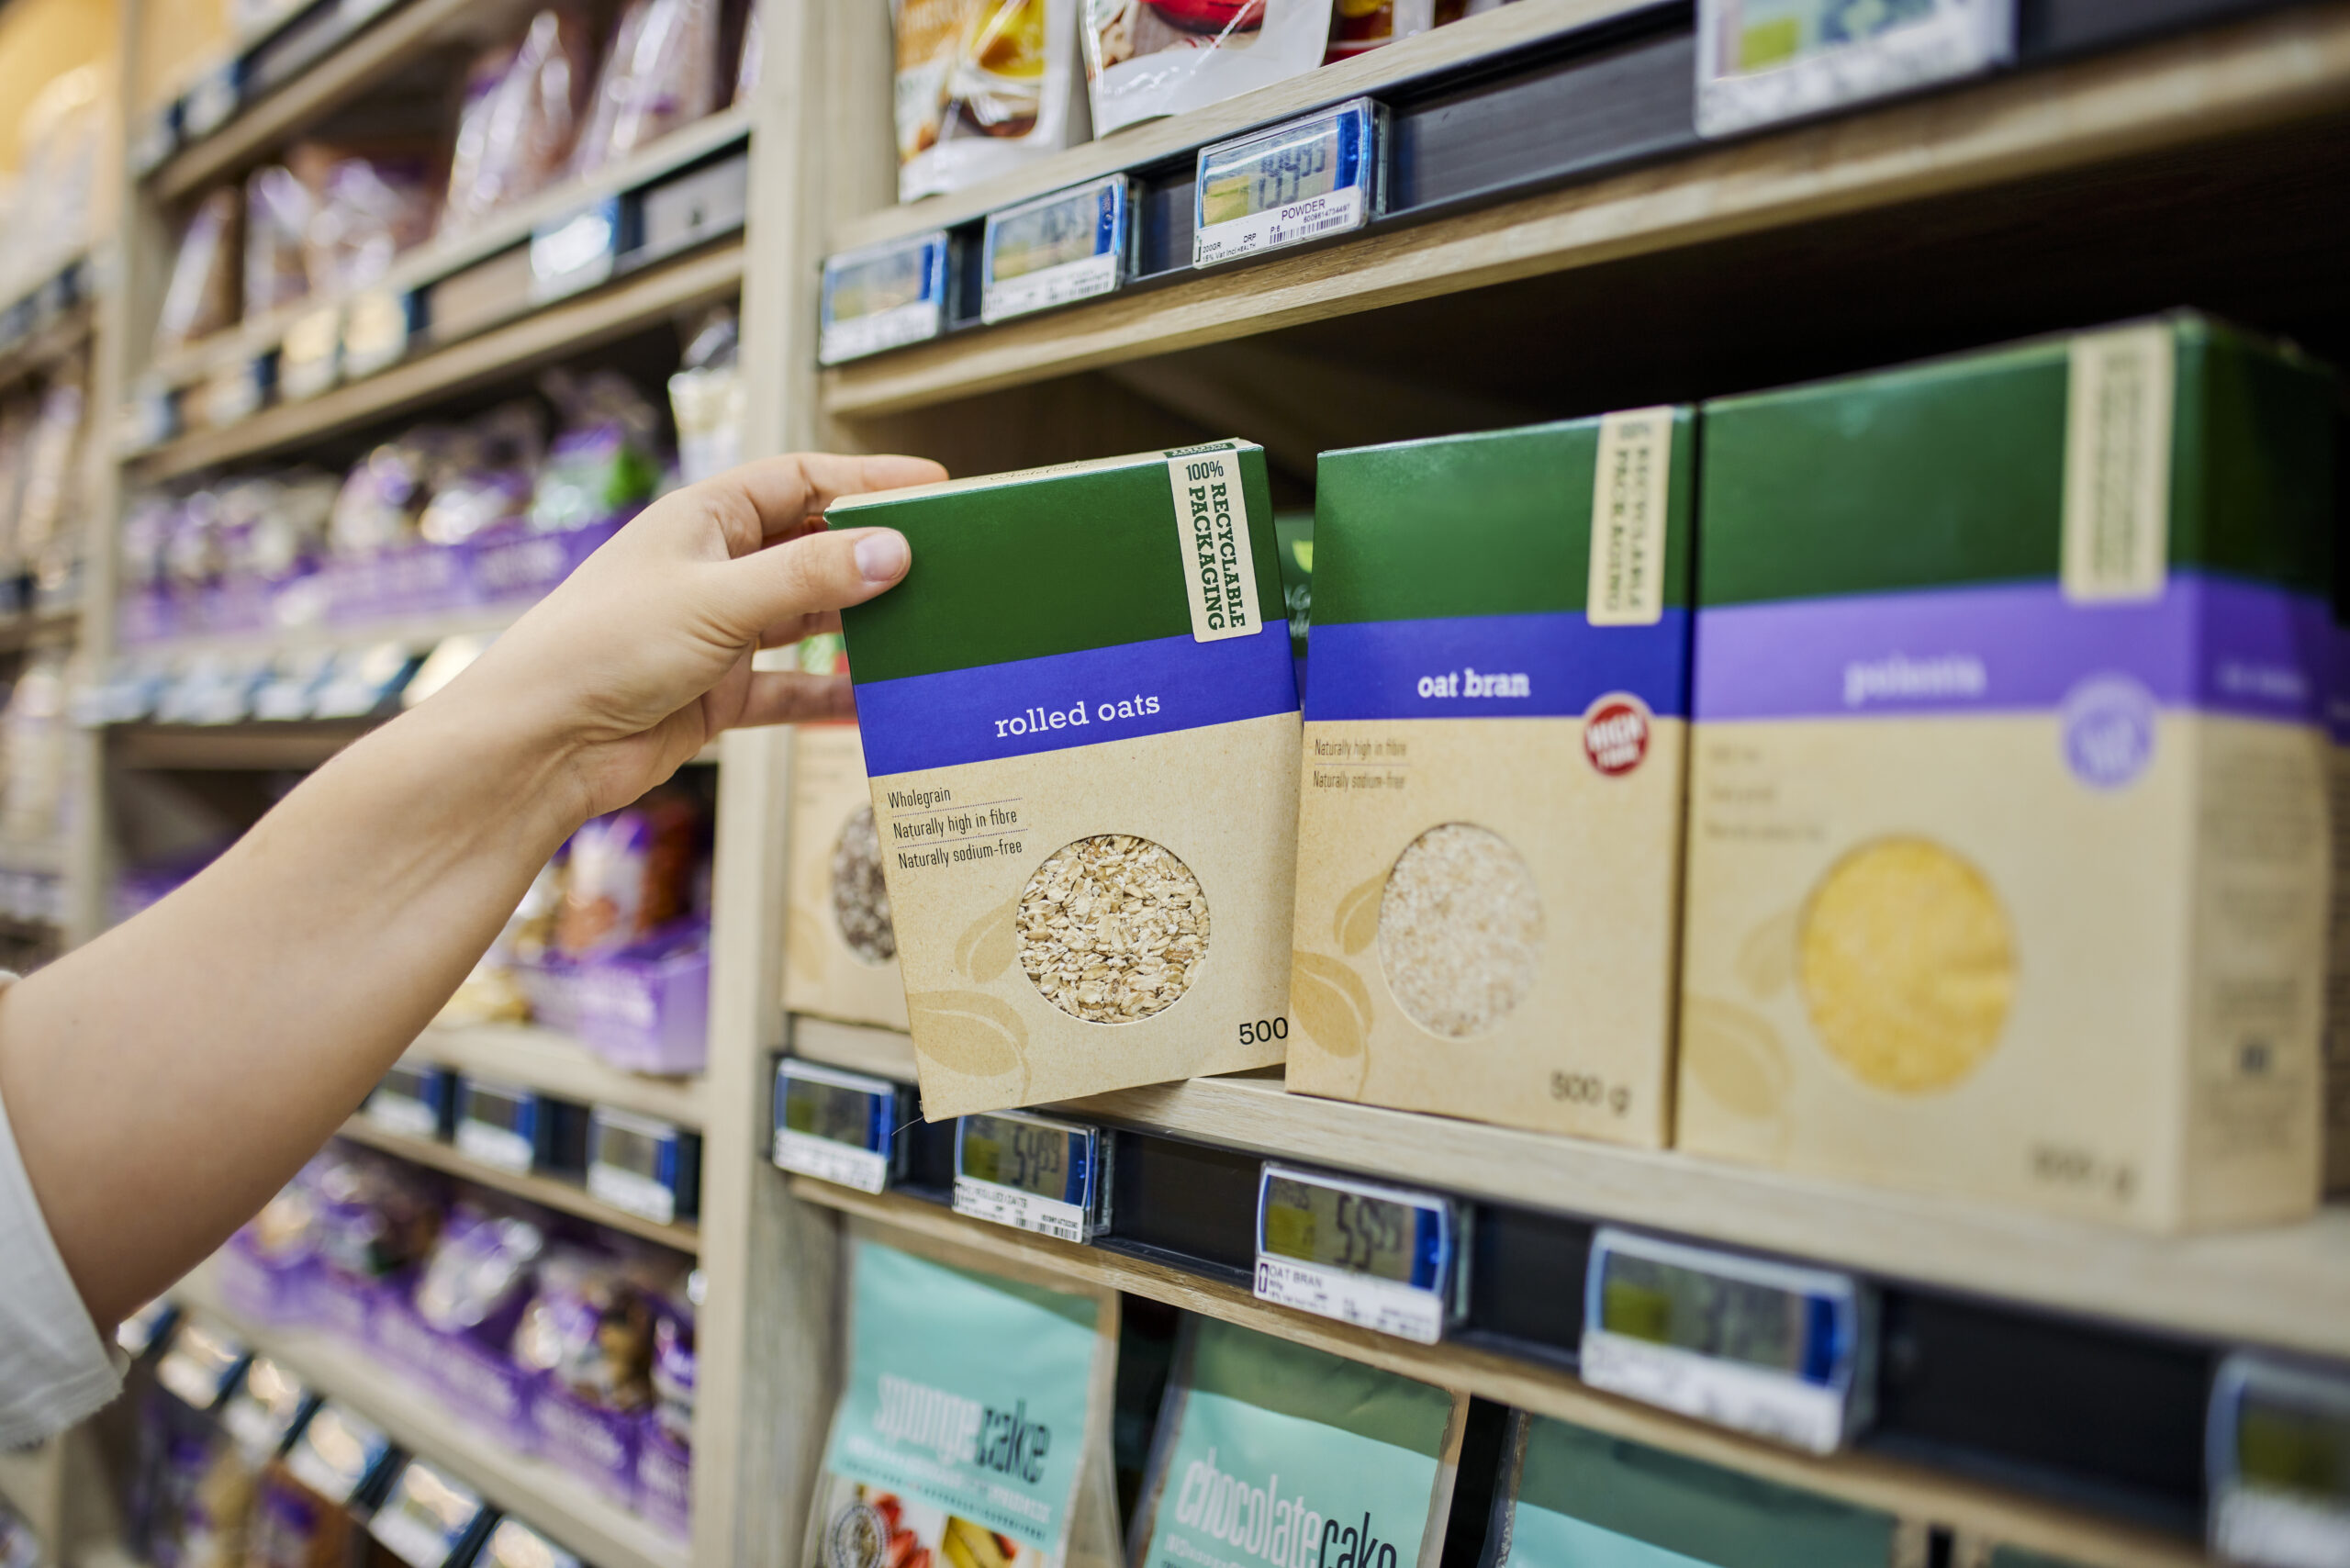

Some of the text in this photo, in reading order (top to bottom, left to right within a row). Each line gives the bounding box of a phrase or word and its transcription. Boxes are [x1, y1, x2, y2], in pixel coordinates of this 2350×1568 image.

[1281, 199, 1326, 220] POWDER
[1185, 460, 1225, 481] 100%
[1189, 485, 1225, 631] PACKAGING
[1210, 482, 1247, 628] RECYCLABLE
[1417, 668, 1531, 699] oat bran
[994, 694, 1161, 738] rolled oats
[1315, 738, 1351, 760] Naturally
[1313, 770, 1349, 793] Naturally
[888, 787, 951, 809] Wholegrain
[893, 808, 1017, 839] Naturally high in fibre
[898, 839, 1023, 869] Naturally sodium-free
[1239, 1016, 1288, 1045] 500
[1269, 1265, 1323, 1288] OAT BRAN
[976, 1397, 1051, 1484] cake
[1175, 1447, 1322, 1568] chocolate
